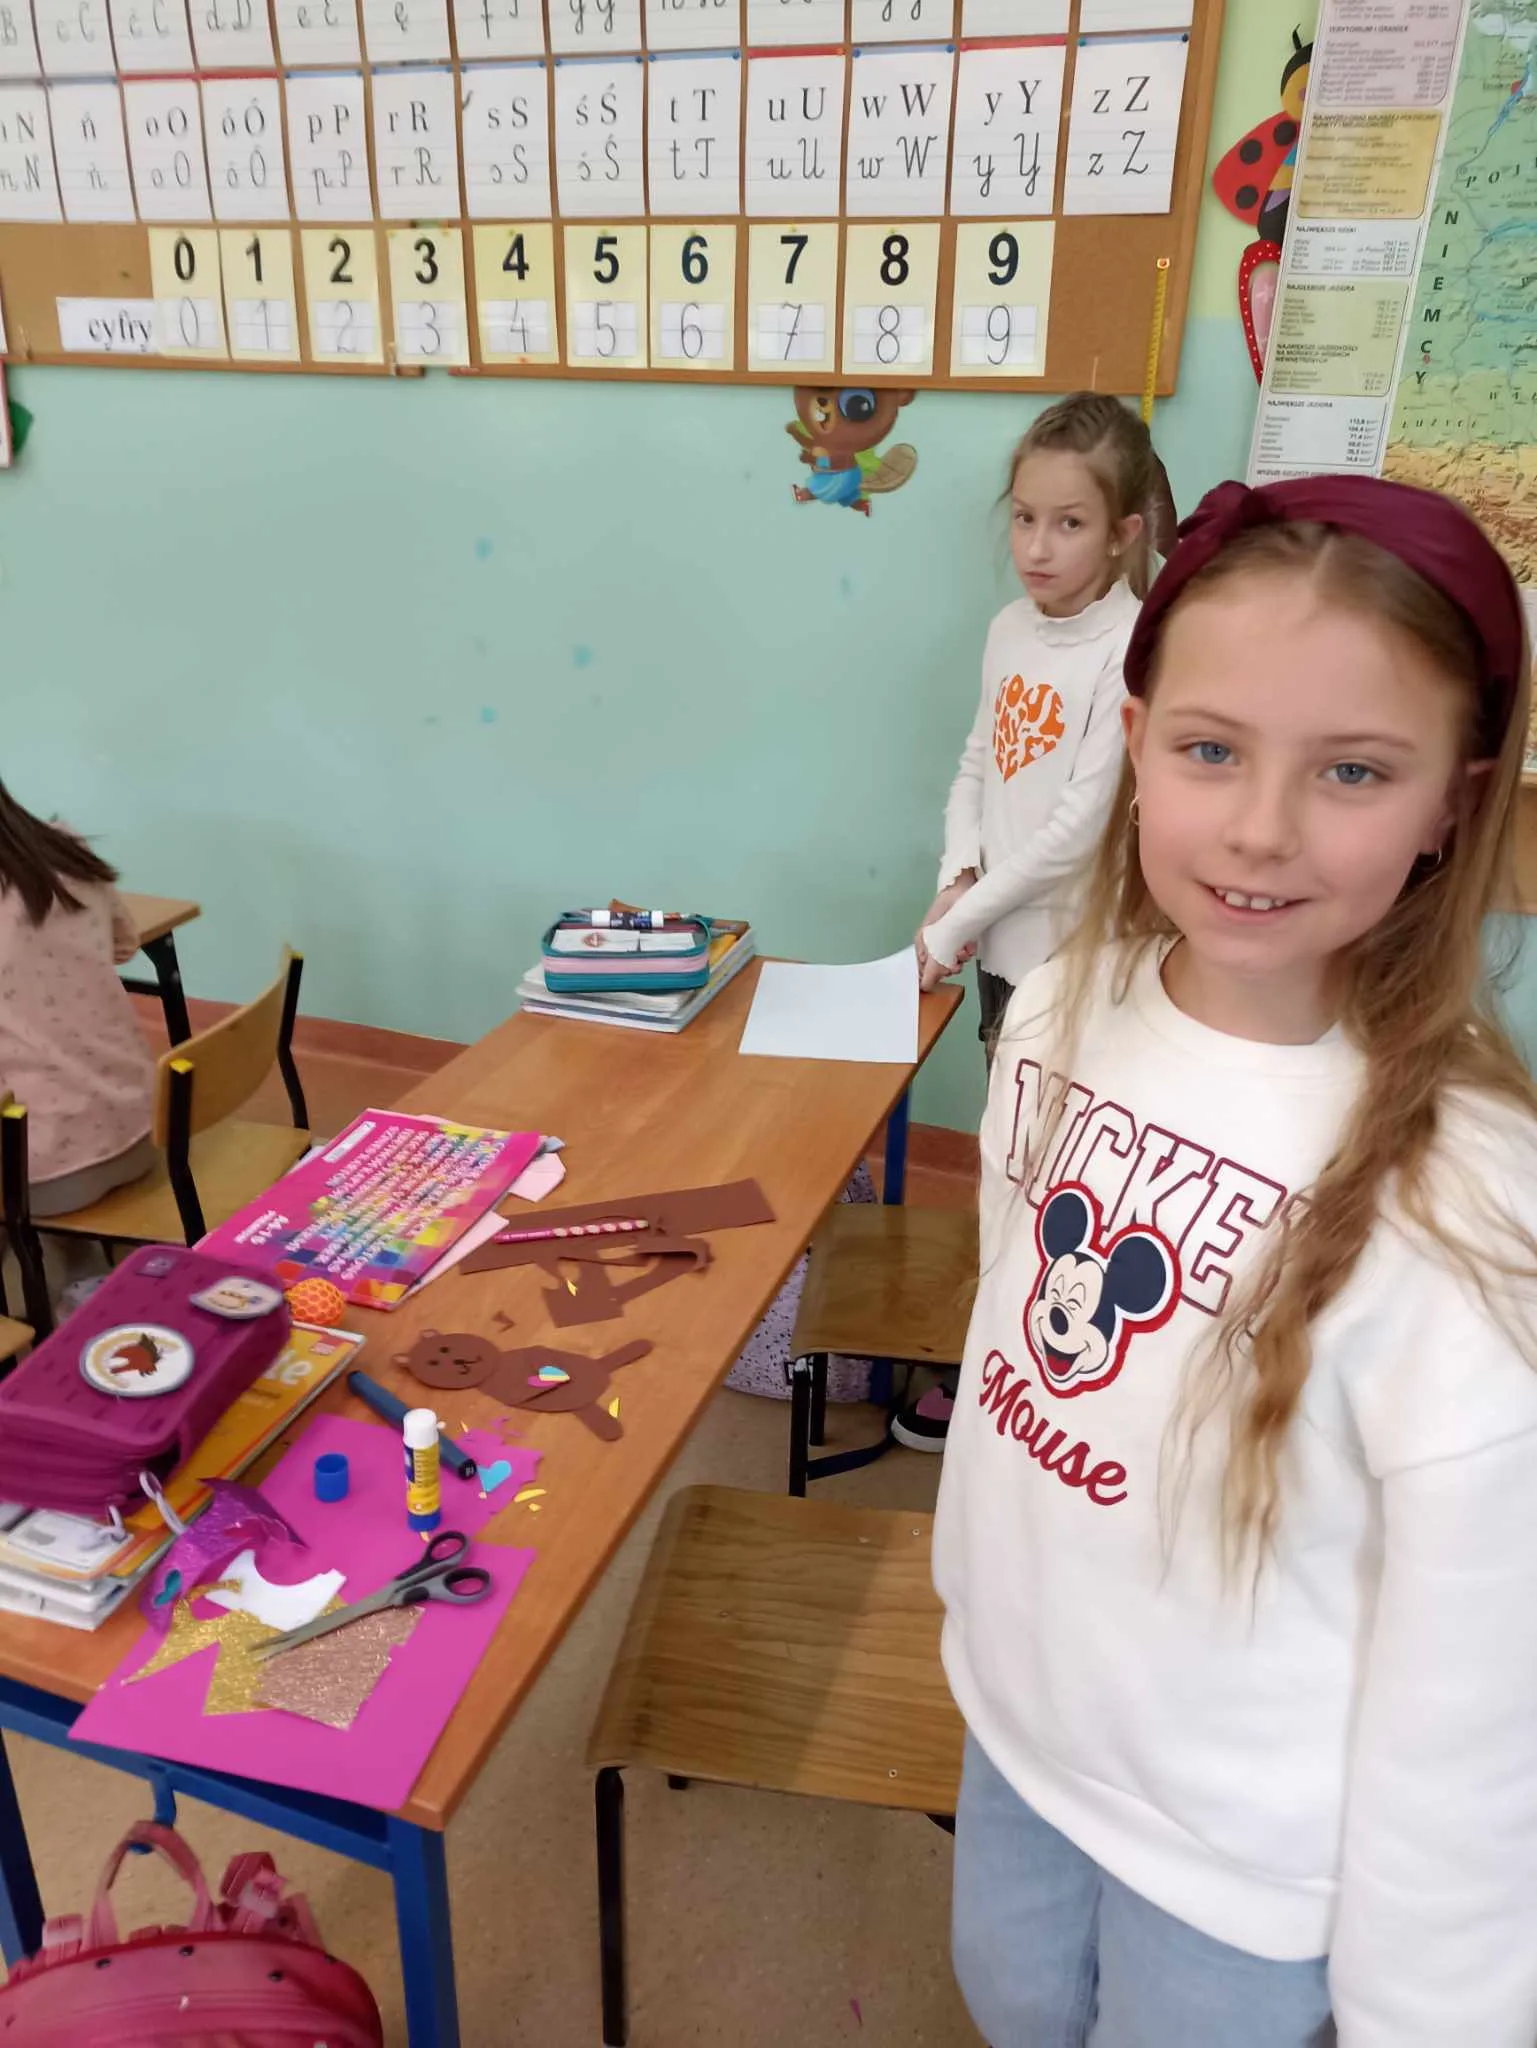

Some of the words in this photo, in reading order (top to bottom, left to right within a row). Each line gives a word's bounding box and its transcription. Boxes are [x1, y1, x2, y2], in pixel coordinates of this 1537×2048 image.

[174, 236, 196, 281] 0
[245, 237, 264, 283] 1
[328, 239, 353, 284] 2
[414, 238, 439, 285] 3
[502, 234, 530, 281] 4
[593, 237, 620, 284] 5
[681, 236, 709, 285] 6
[780, 235, 809, 284] 7
[880, 234, 909, 286] 8
[988, 231, 1019, 286] 9
[88, 309, 152, 353] cyfry
[179, 297, 199, 347] 0
[255, 300, 271, 349] 1
[335, 300, 356, 352] 2
[419, 301, 441, 355] 3
[510, 299, 530, 353] 4
[595, 302, 616, 357] 5
[680, 302, 703, 359] 6
[783, 302, 803, 360] 7
[875, 304, 900, 364] 8
[987, 304, 1011, 365] 9
[979, 1349, 1128, 1506] Mouse
